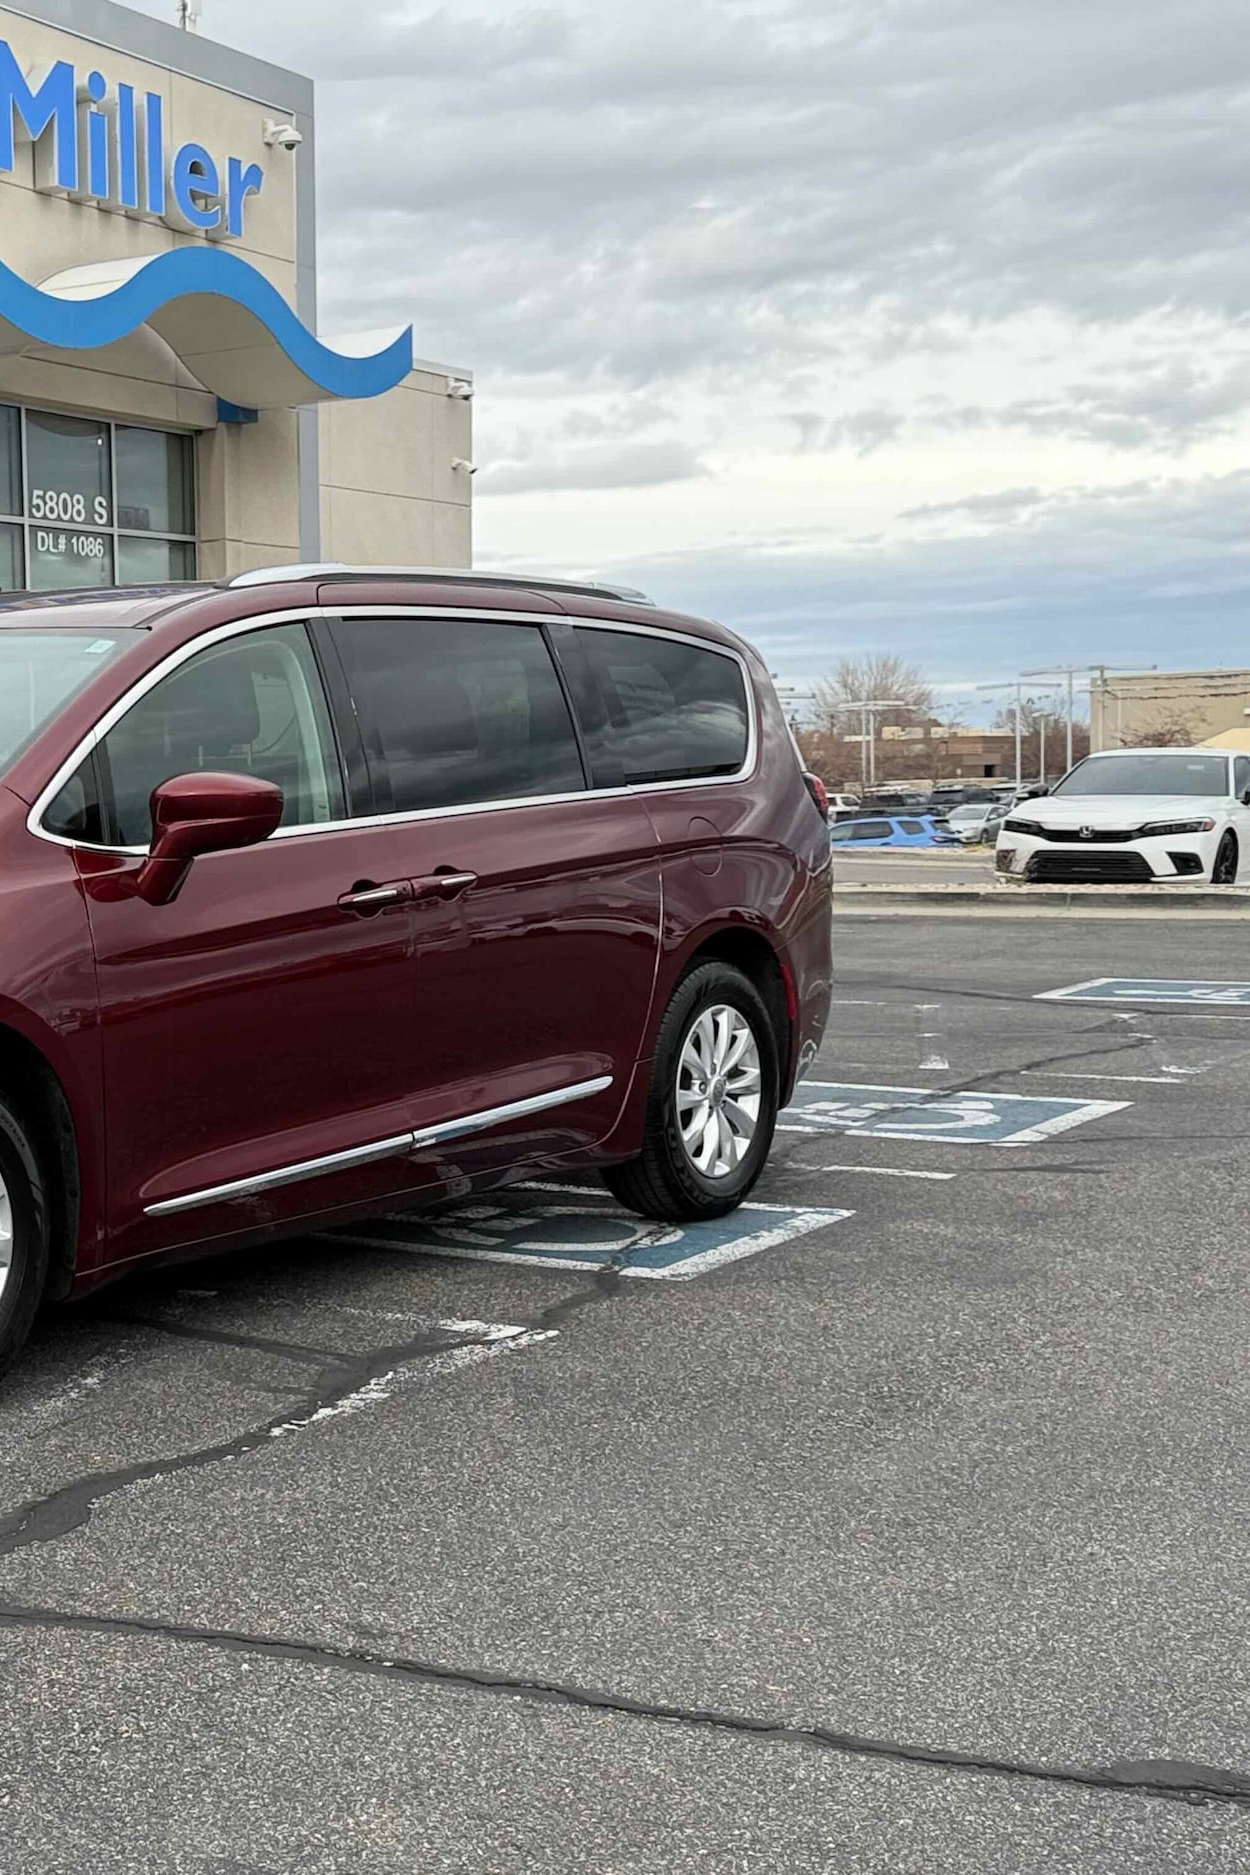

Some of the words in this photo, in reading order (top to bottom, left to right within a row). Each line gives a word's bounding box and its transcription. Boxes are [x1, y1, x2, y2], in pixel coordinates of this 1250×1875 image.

[31, 489, 86, 523] 5808
[93, 496, 108, 525] S
[37, 531, 66, 553] DL#
[71, 535, 104, 558] 1086
